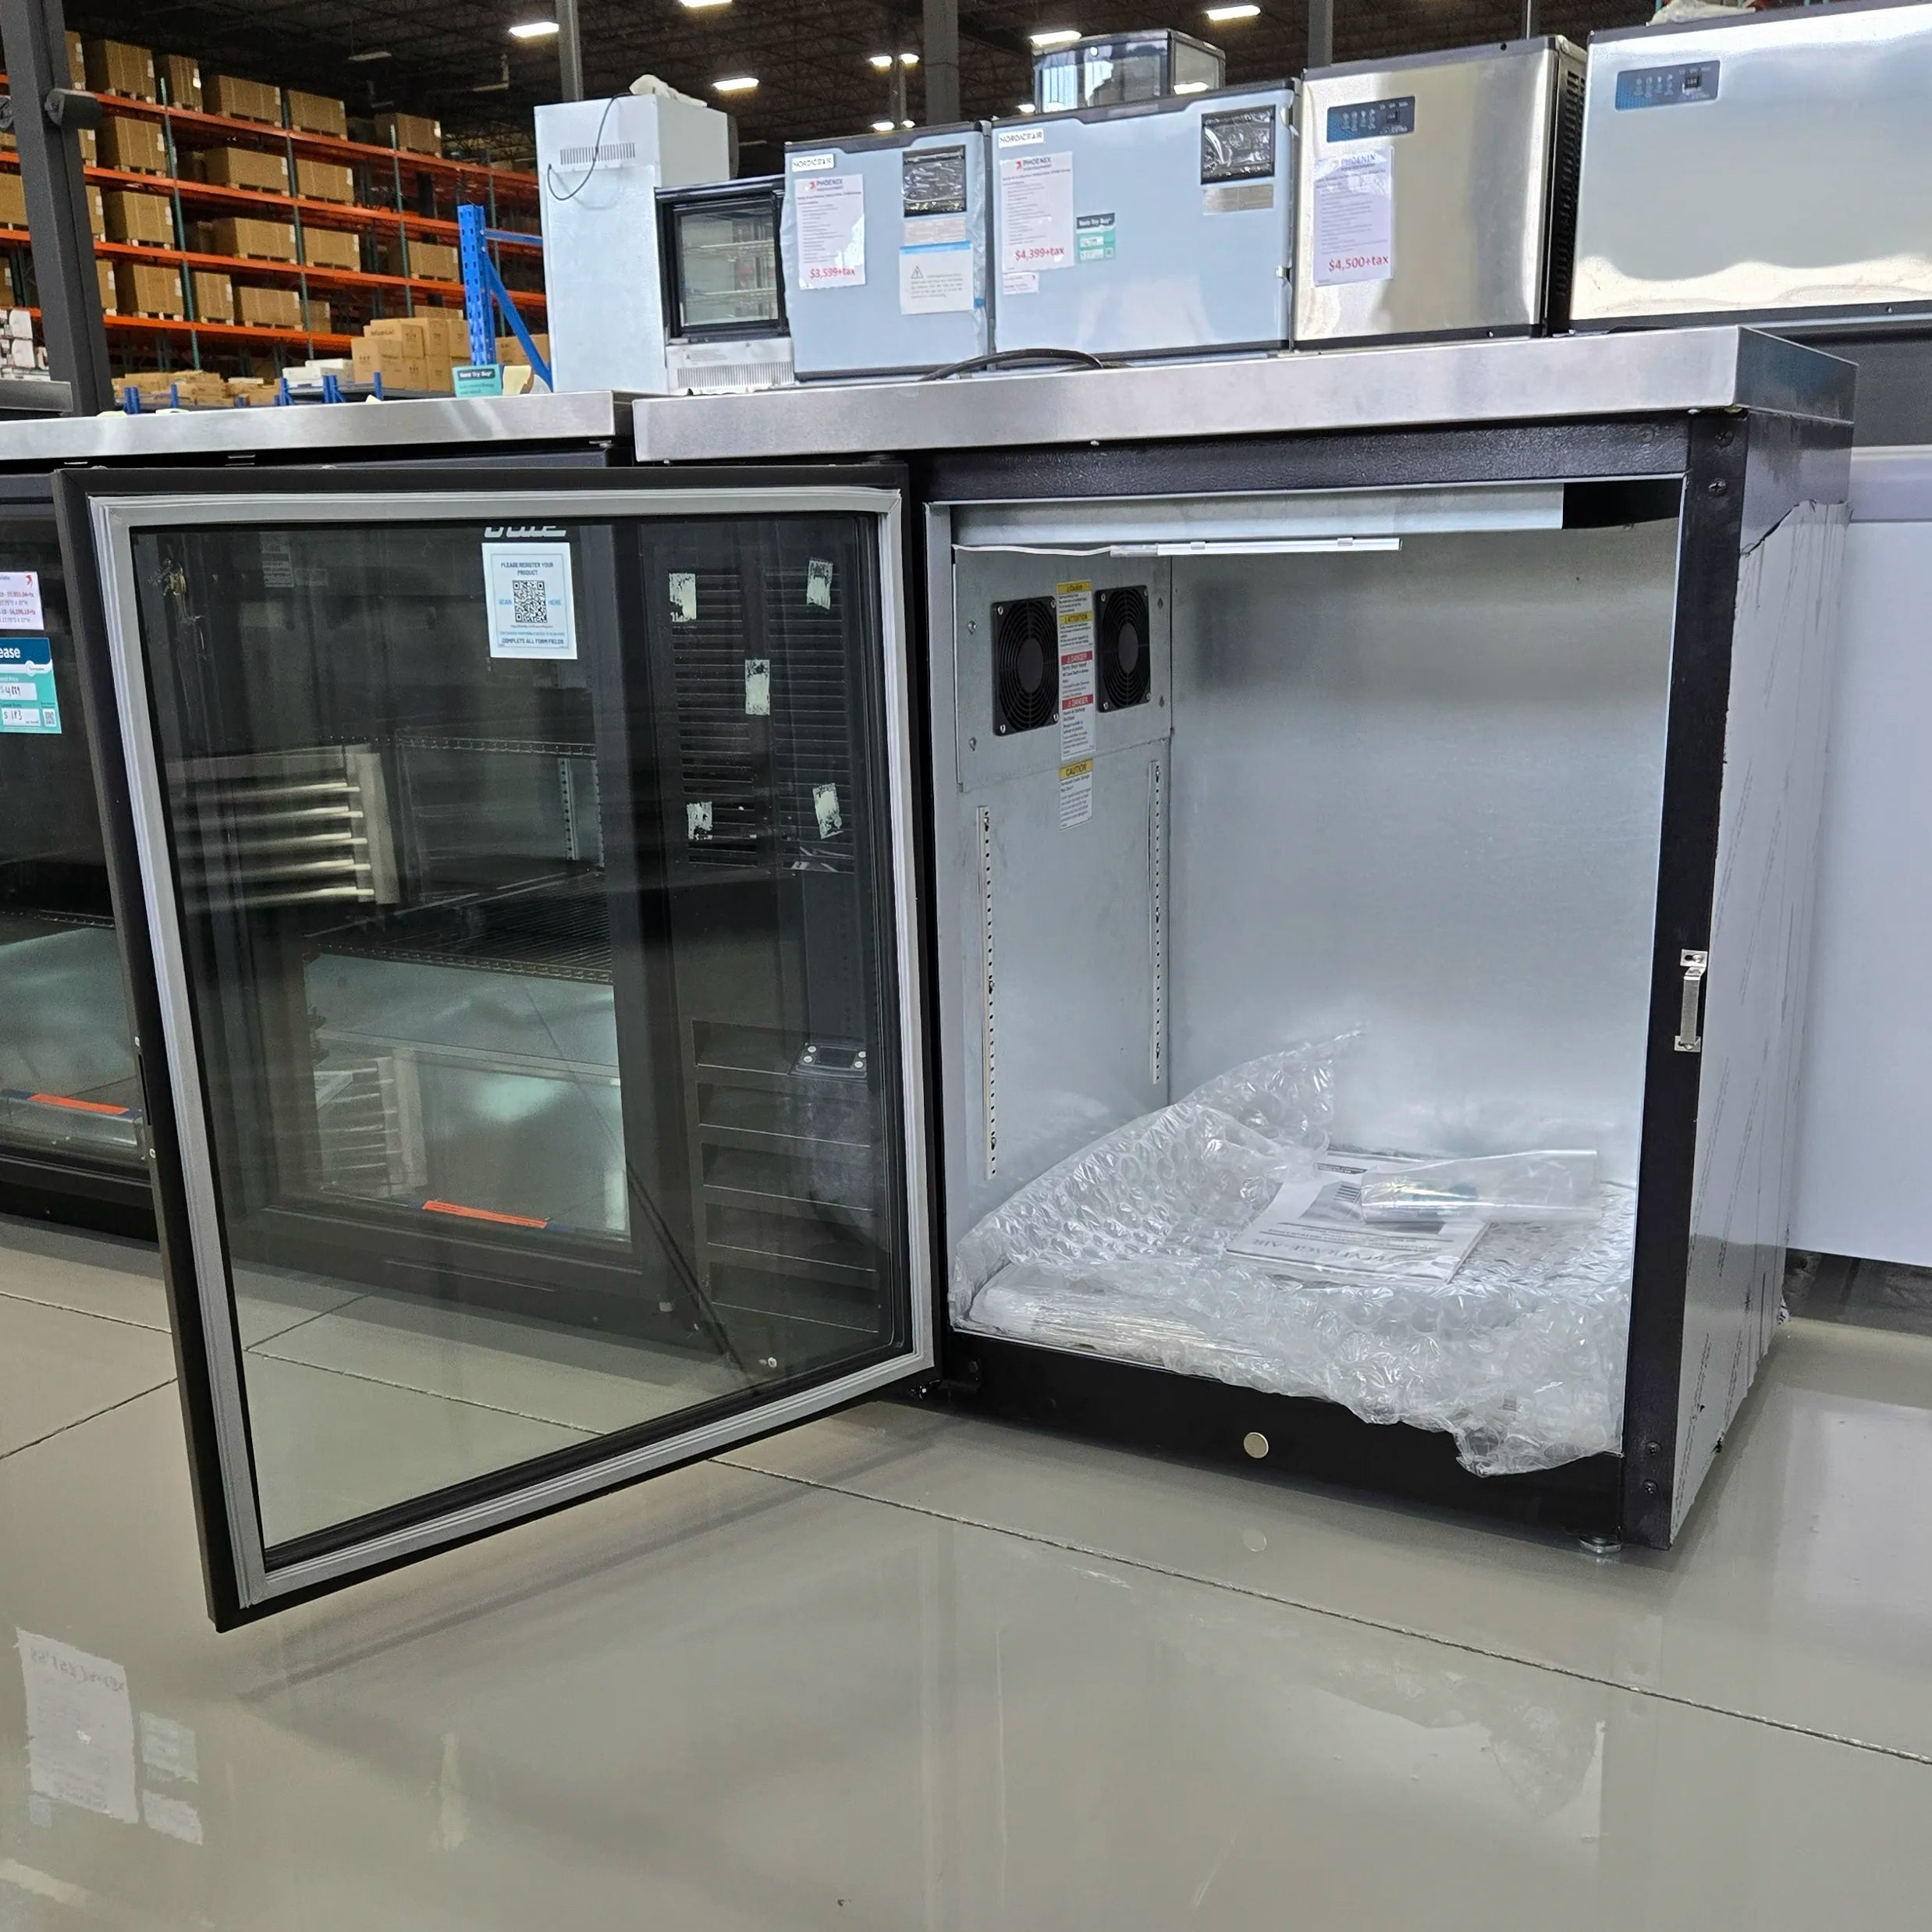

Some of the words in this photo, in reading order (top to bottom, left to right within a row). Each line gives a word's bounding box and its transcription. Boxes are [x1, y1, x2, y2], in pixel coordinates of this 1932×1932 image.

[1023, 157, 1051, 165] PHOENIX
[1341, 154, 1376, 165] PHOENIX
[1015, 247, 1064, 261] $4,399+tax
[1328, 256, 1389, 272] $4,500+tax
[810, 268, 855, 279] $3,599+tax
[1070, 653, 1088, 662] DANGER
[1071, 696, 1089, 707] DANGER
[1066, 763, 1087, 776] CAUTION
